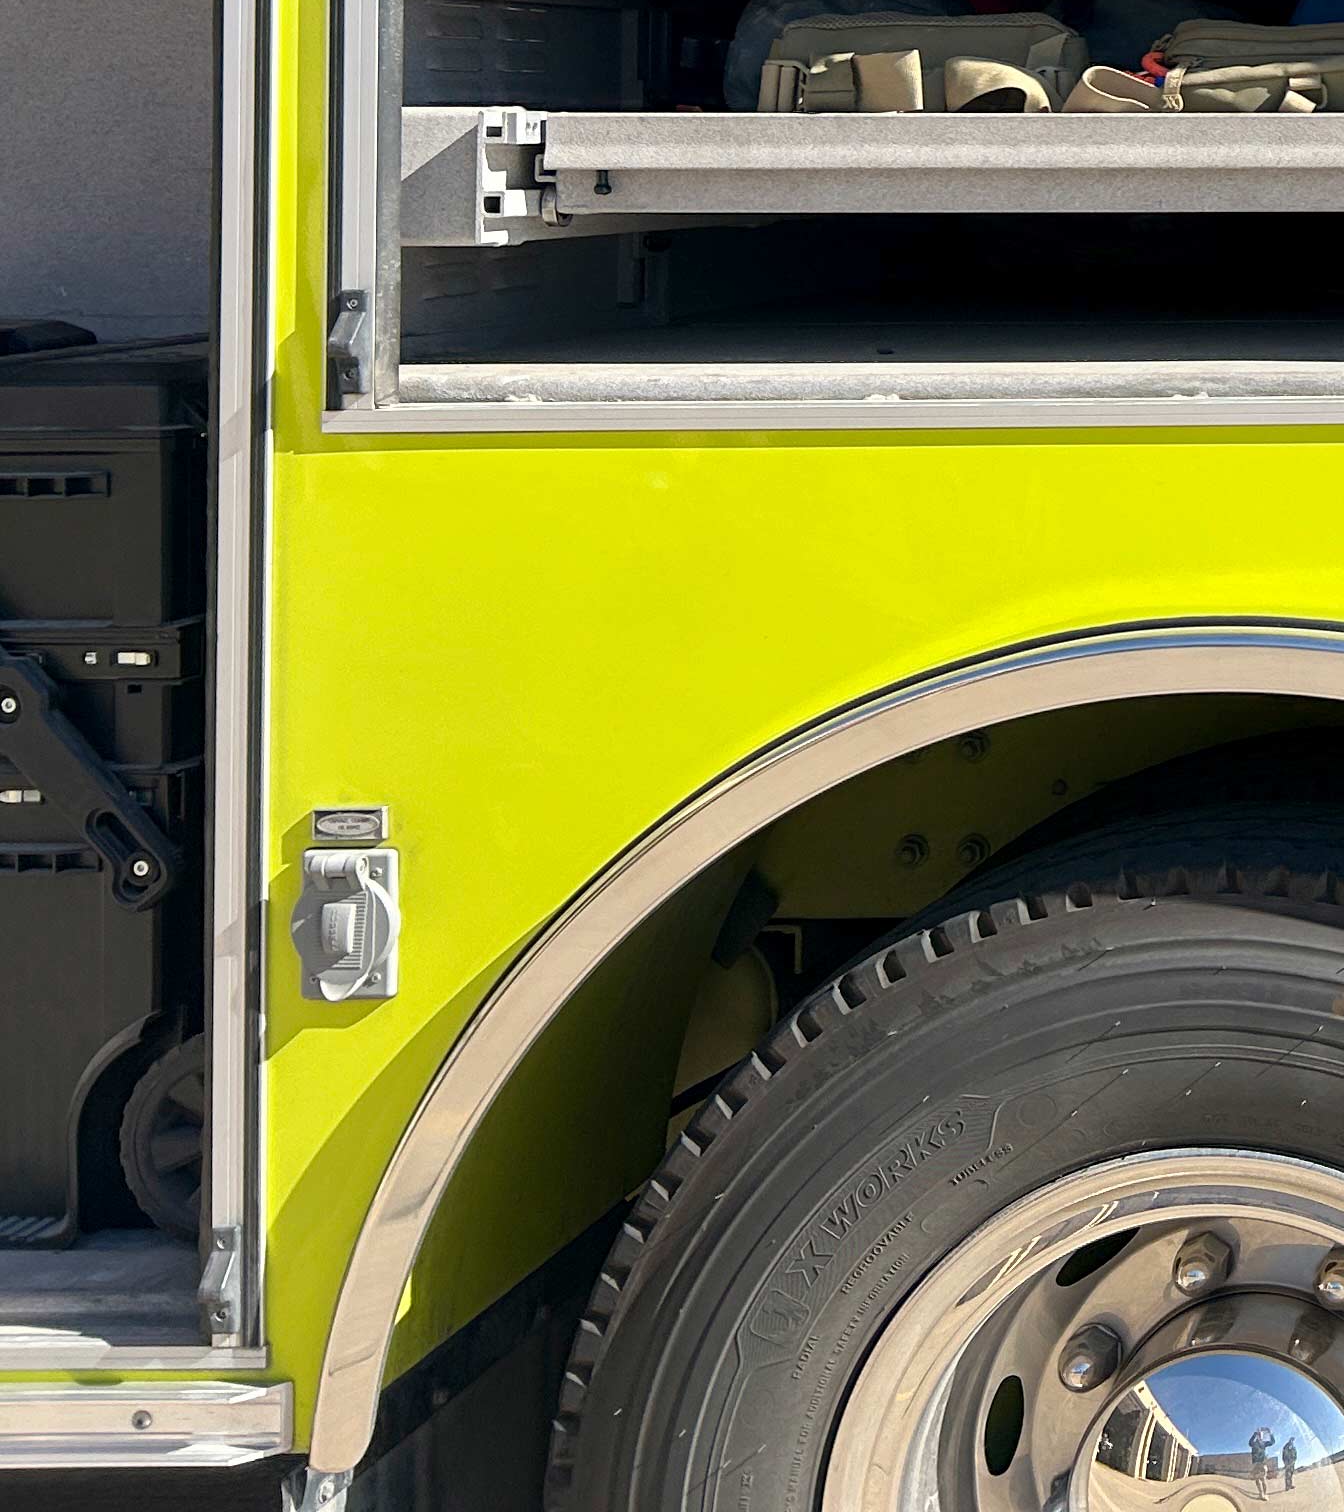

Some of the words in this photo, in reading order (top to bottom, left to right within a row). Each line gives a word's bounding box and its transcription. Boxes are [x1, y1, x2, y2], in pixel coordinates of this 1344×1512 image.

[785, 1239, 834, 1288] X
[819, 1110, 966, 1240] WORKS
[840, 1211, 915, 1294] REGROOVABLE
[791, 1335, 821, 1381] RADIAL
[833, 1314, 861, 1357] SAFETY
